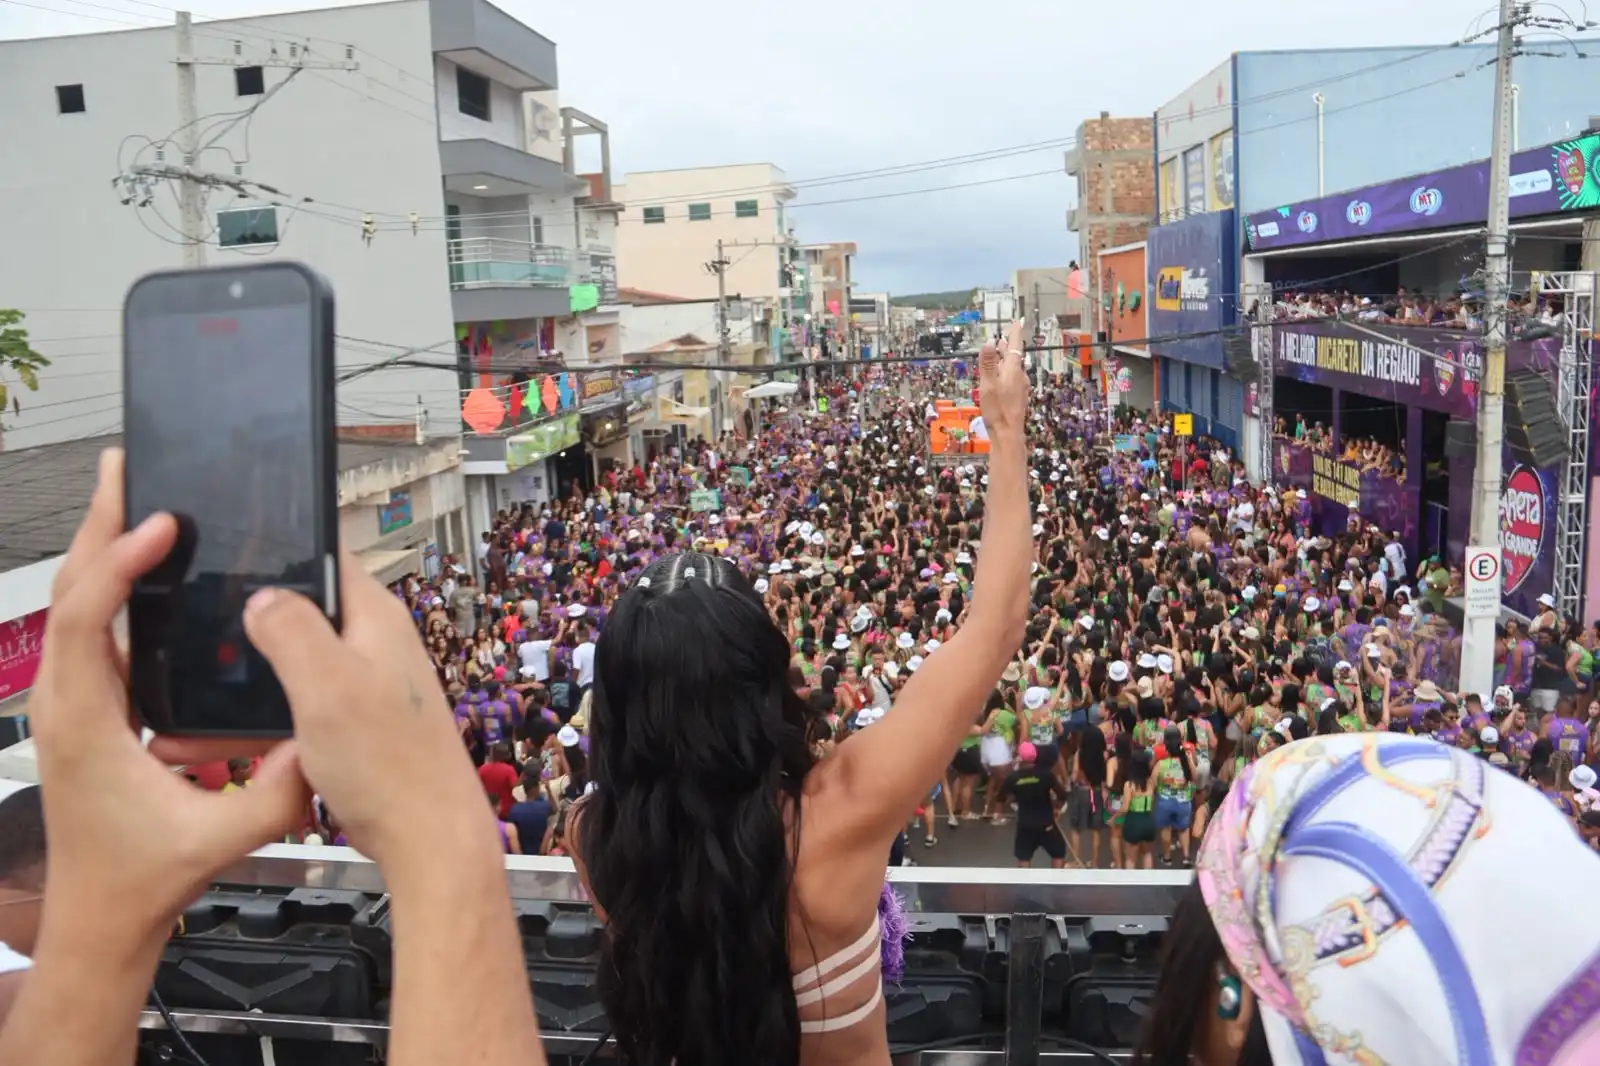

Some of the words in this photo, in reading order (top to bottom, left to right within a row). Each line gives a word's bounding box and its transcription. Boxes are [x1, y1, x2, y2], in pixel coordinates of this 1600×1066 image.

[1279, 331, 1286, 360] A
[1286, 332, 1316, 366] MELHOR
[1317, 336, 1360, 374] MICARETA
[1361, 340, 1375, 377] DA
[1376, 338, 1420, 386] REGIÃO!
[1478, 559, 1489, 576] E
